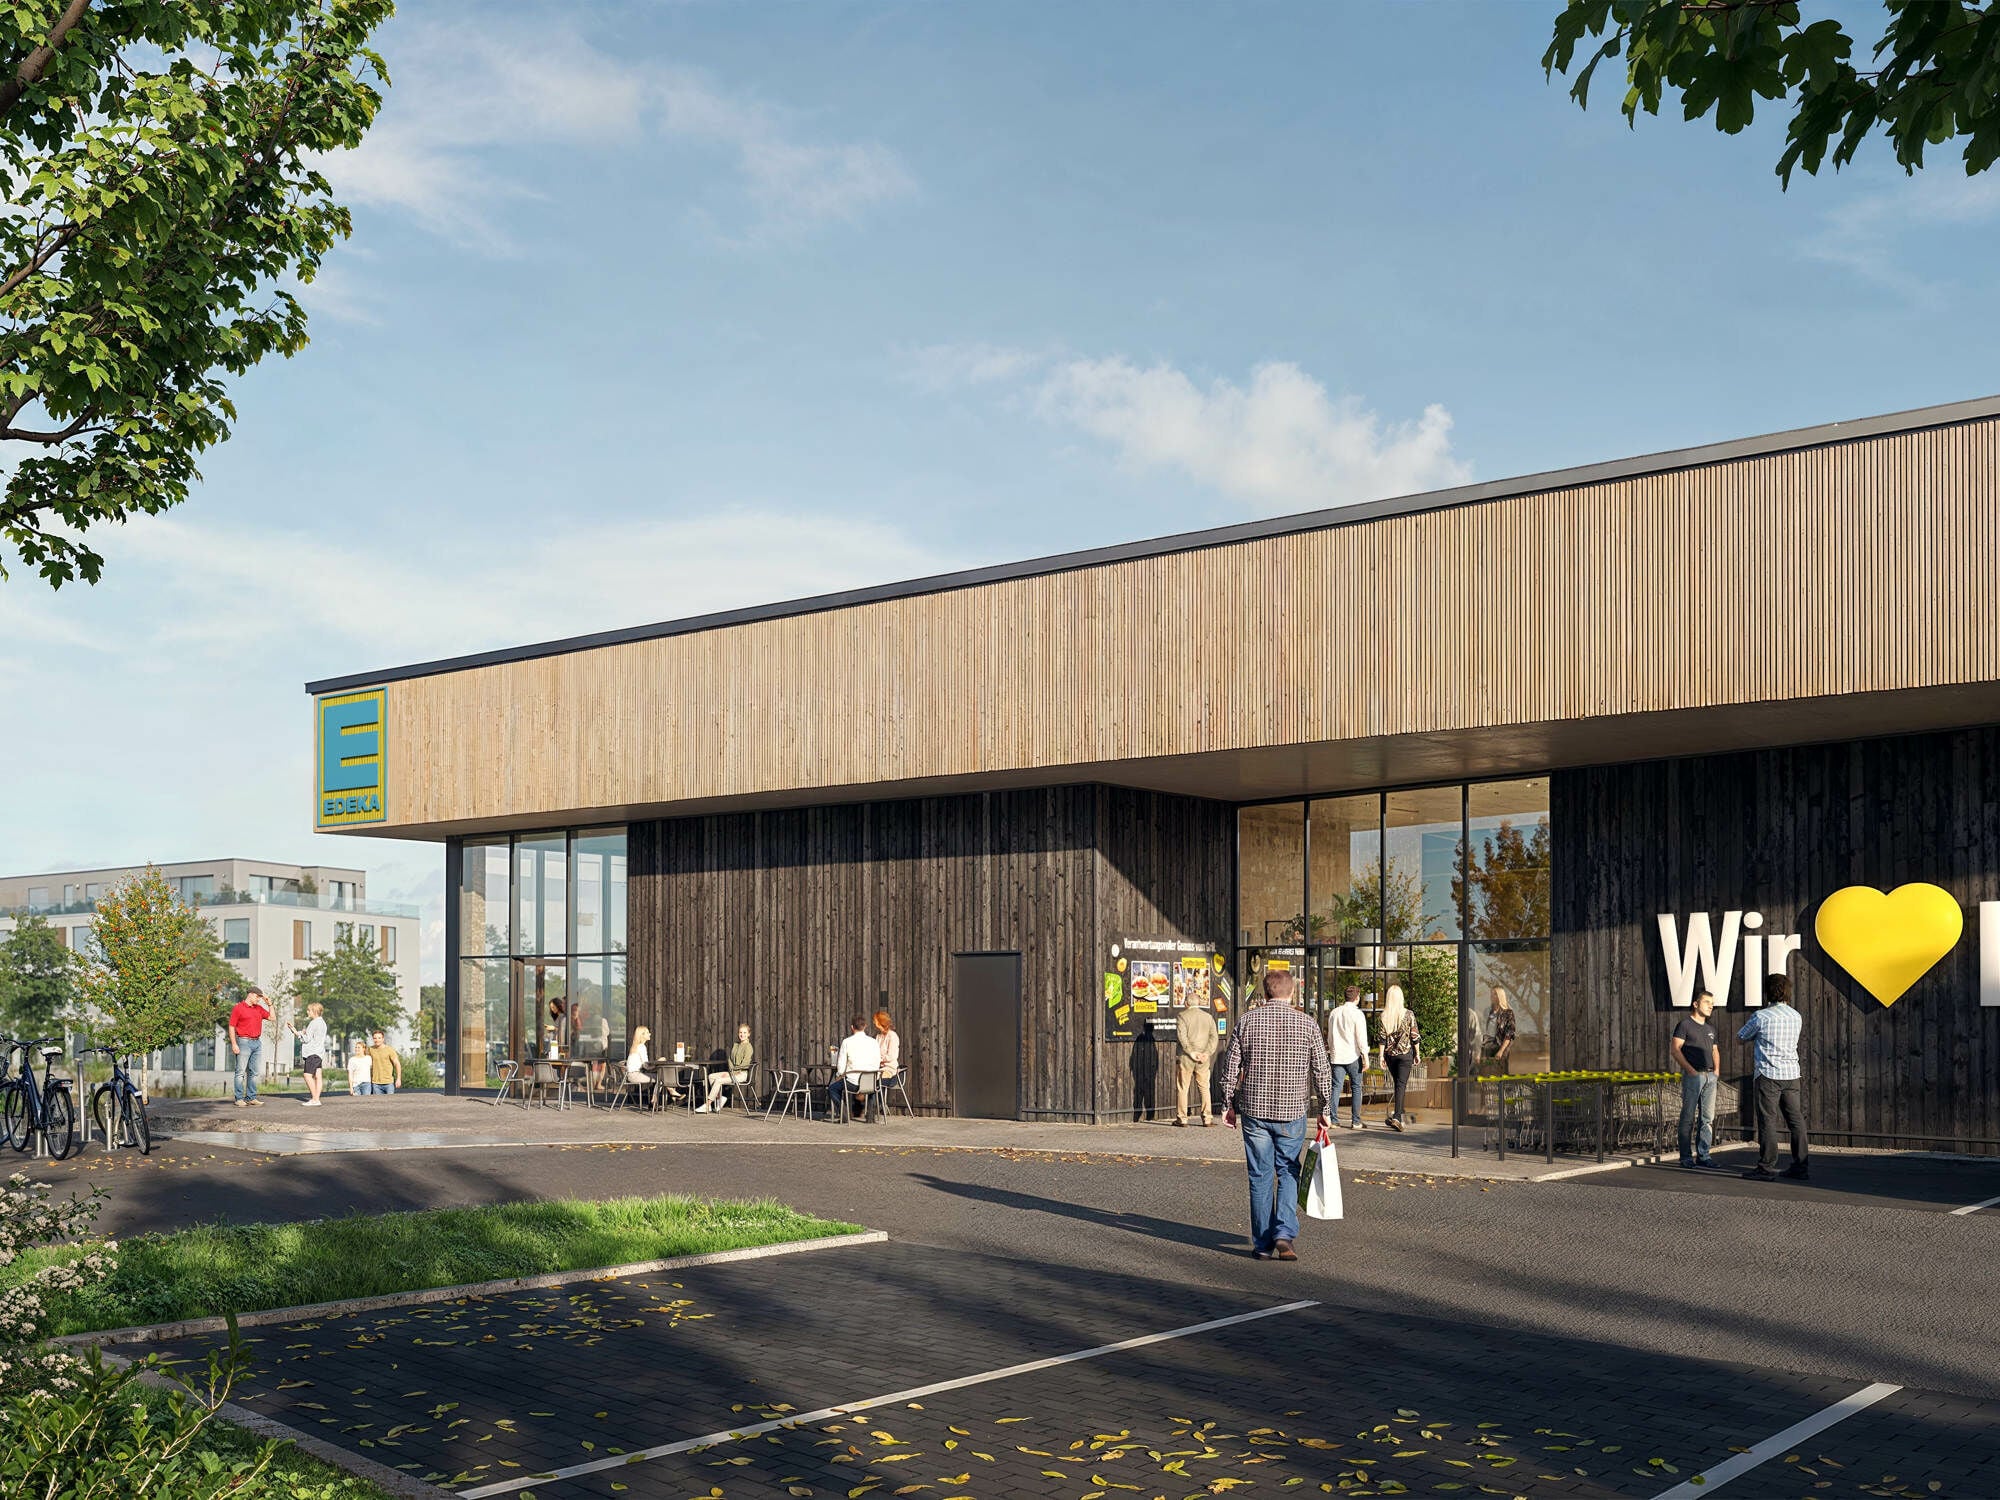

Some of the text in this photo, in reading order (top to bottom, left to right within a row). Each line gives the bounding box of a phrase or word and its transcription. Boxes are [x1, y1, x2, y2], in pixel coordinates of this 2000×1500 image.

[324, 699, 378, 792] E
[323, 794, 380, 816] EDEKA
[1657, 911, 1801, 1007] Wir
